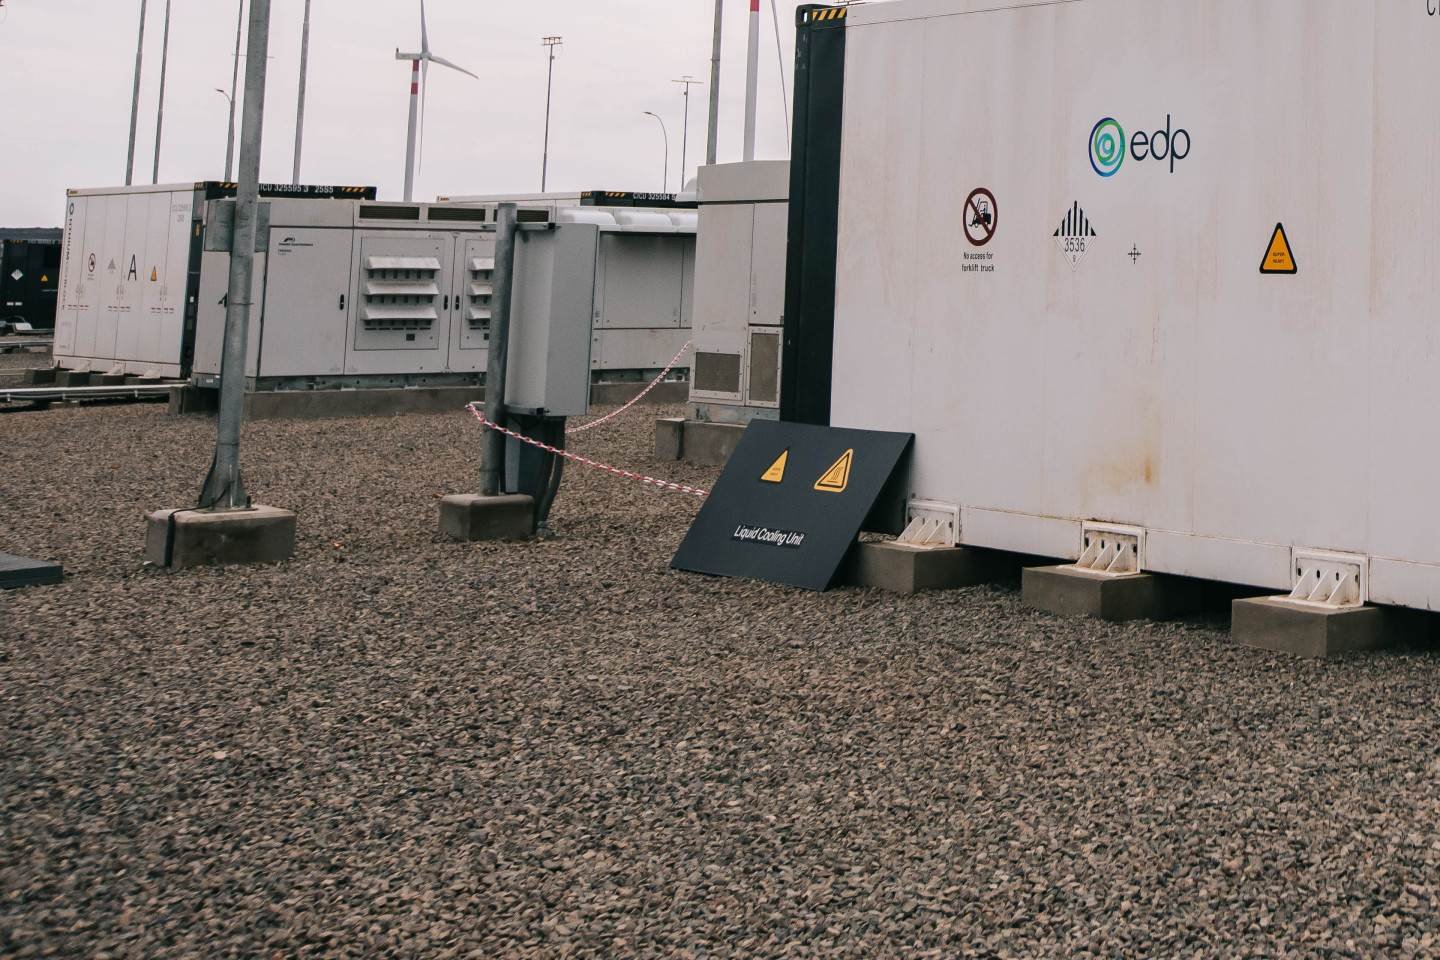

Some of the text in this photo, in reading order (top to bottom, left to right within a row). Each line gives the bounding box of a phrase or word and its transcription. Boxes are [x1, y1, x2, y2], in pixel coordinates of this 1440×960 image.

[1130, 114, 1190, 173] edp
[1065, 237, 1085, 252] 3536
[128, 254, 137, 281] A
[961, 264, 995, 272] forklift truck
[734, 525, 805, 546] Liquid Cooling Unit
